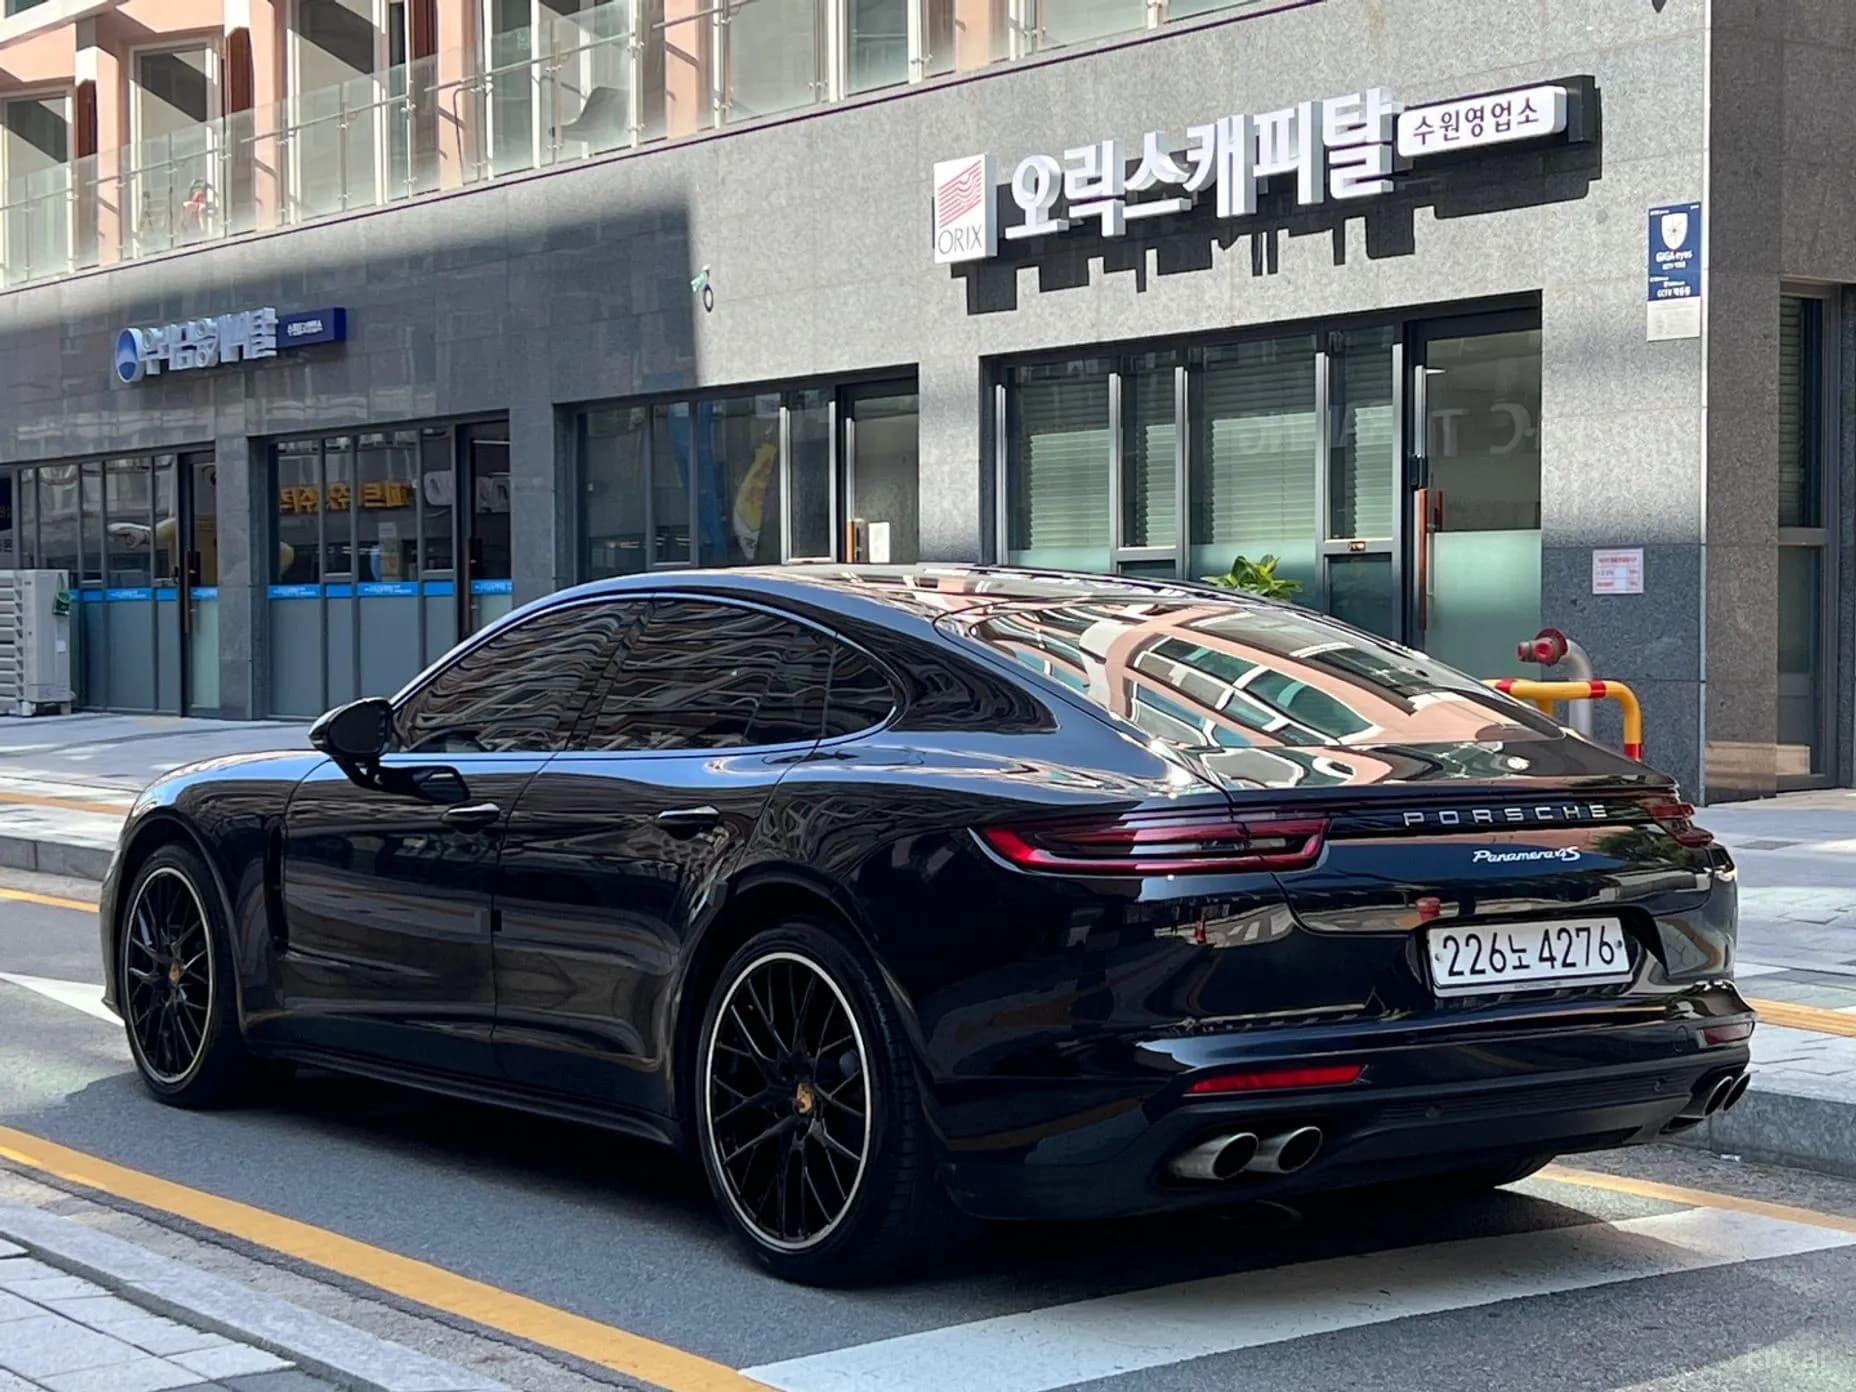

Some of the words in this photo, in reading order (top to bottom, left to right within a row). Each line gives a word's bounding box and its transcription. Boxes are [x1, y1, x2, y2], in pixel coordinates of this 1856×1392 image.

[1414, 98, 1539, 145] 수원영업소
[1005, 88, 1394, 239] 오릭스캐피탈
[938, 224, 982, 255] ORIX
[1403, 805, 1608, 827] PORSCHE
[1472, 850, 1553, 863] Panamera
[1443, 932, 1530, 977] 226노
[1538, 925, 1615, 969] 4276
